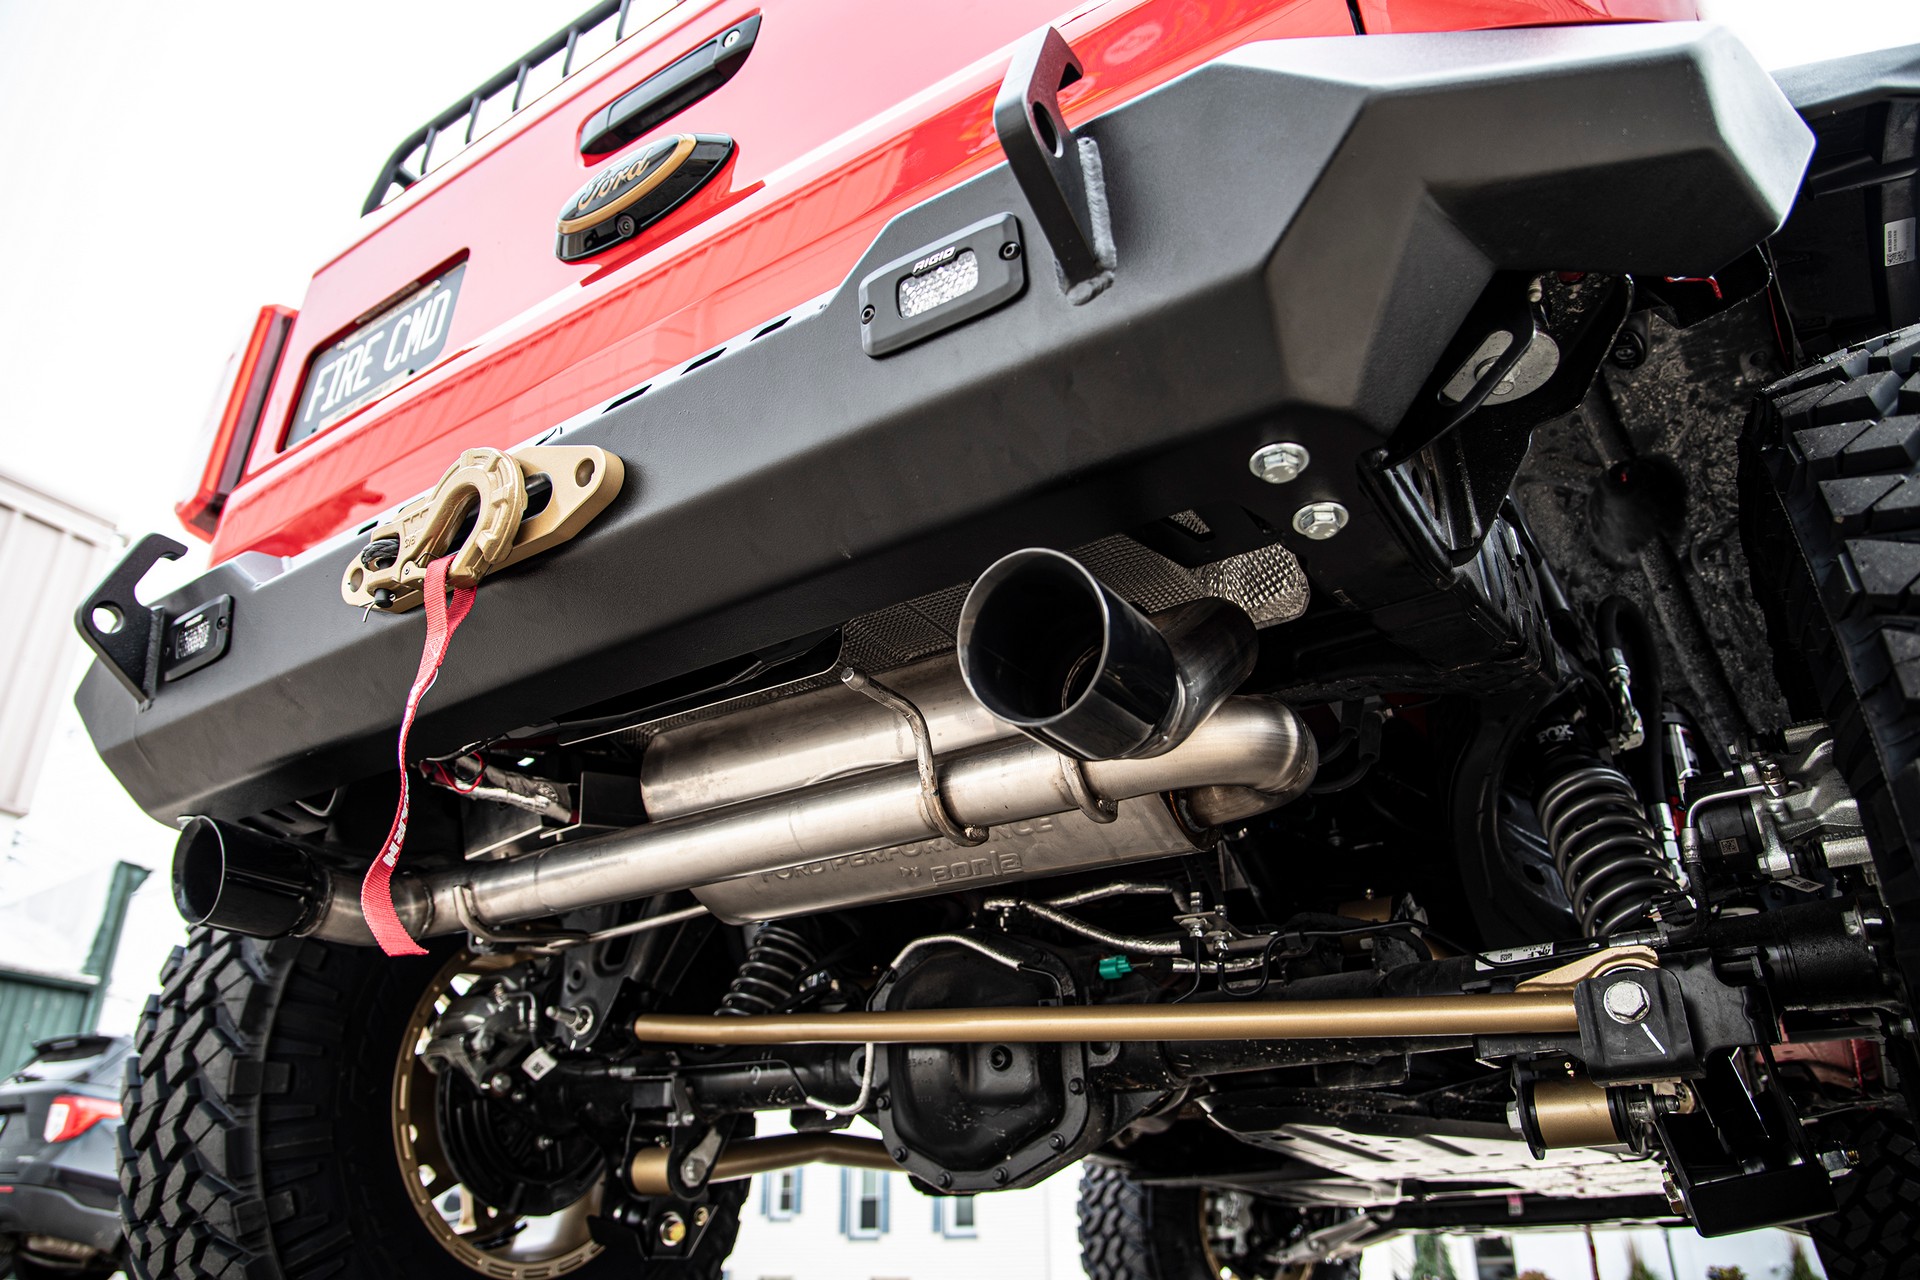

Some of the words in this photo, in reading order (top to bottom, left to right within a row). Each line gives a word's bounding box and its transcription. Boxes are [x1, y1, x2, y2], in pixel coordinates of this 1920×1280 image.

[577, 147, 654, 211] Ford
[912, 246, 956, 273] RIGID
[304, 330, 384, 422] FIRE
[383, 288, 452, 372] CMD
[1536, 725, 1574, 744] FOX
[830, 816, 1053, 872] PERFORNCE
